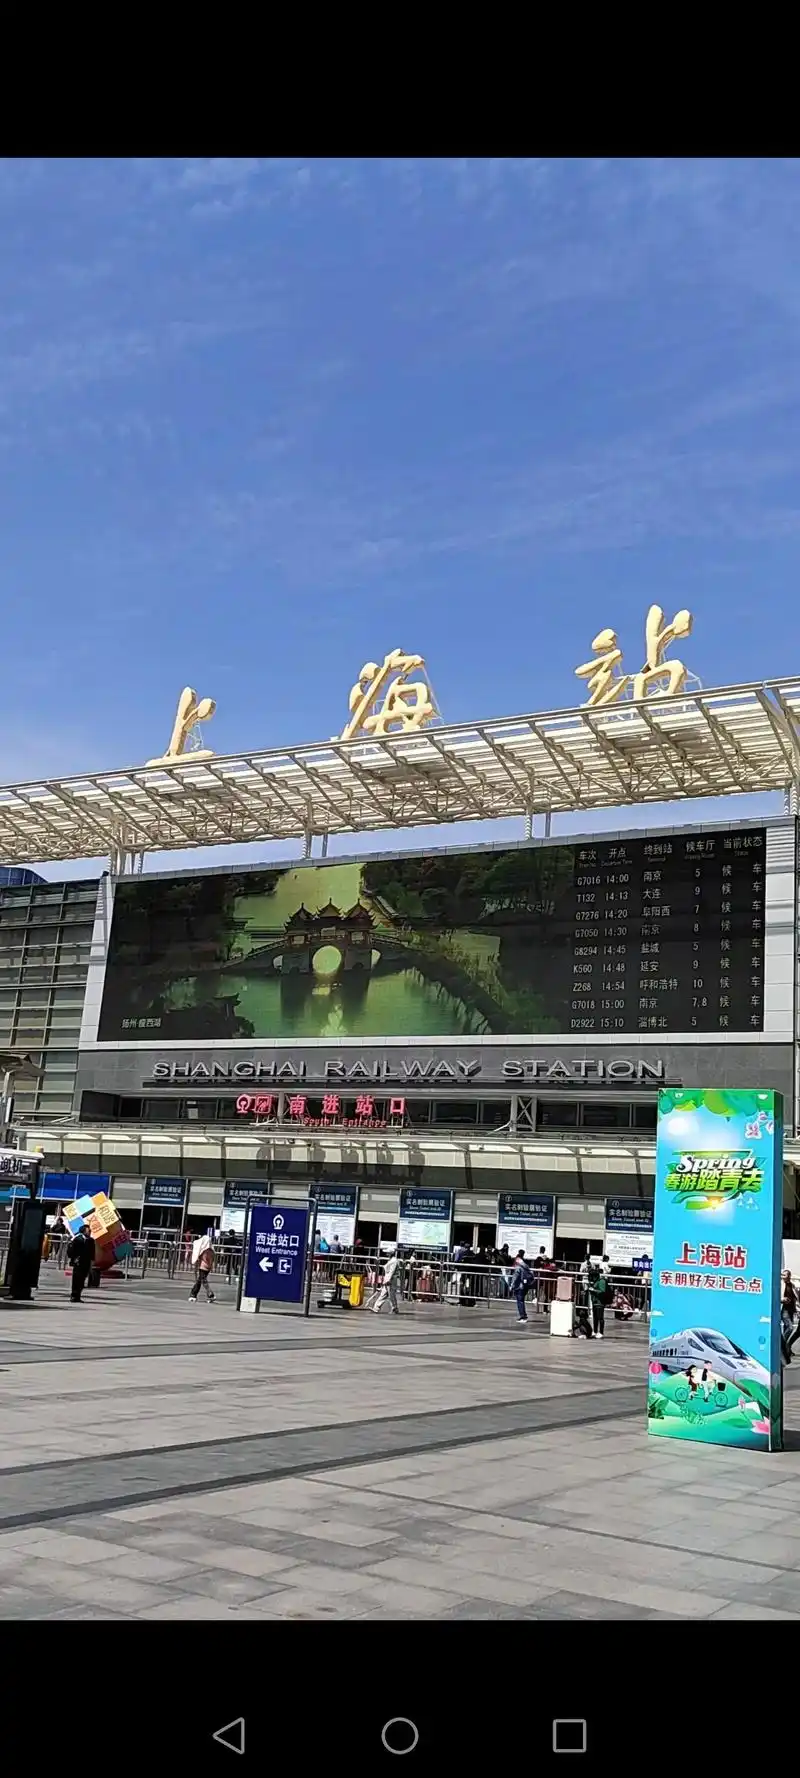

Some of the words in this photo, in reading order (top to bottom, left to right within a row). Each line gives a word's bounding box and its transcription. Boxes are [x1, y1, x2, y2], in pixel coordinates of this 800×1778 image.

[579, 849, 597, 860] 车次
[608, 847, 627, 859] 开点
[643, 843, 672, 855] 终到站
[685, 840, 715, 852] 候车厅
[723, 836, 763, 849] 当前状态
[578, 876, 600, 886] G7016
[606, 874, 629, 884] 14:00
[644, 871, 661, 882] 南京
[695, 869, 701, 877] 5
[577, 894, 595, 902] T132
[605, 892, 628, 901] 14:13
[643, 889, 661, 900] 大连
[695, 887, 700, 896] 9
[576, 911, 599, 921] G7276
[604, 910, 628, 919] 14:20
[642, 906, 671, 917] 阜阳西
[695, 905, 700, 914] 7
[575, 929, 598, 938] G7050
[604, 927, 627, 937] 14:30
[694, 924, 699, 932] 8
[603, 945, 626, 954] 14:45
[693, 942, 698, 951] 5
[573, 964, 592, 973] K560
[602, 963, 625, 973] 14:48
[640, 961, 659, 972] 延安
[693, 960, 698, 968] 9
[573, 982, 592, 992] Z268
[602, 981, 625, 990] 14:54
[640, 979, 678, 990] 呼和浩特
[693, 979, 703, 988] 10
[572, 1000, 595, 1009] G7018
[601, 999, 625, 1009] 15:00
[639, 998, 658, 1009] 南京
[571, 1019, 595, 1028] D2922
[600, 1018, 624, 1028] 15:10
[638, 1016, 668, 1028] 淄博北
[692, 1016, 697, 1026] 5
[153, 1060, 305, 1077] SHANGHAI
[324, 1060, 478, 1077] RAILWAY
[501, 1060, 663, 1077] STATION
[289, 1095, 405, 1115] 南进站口
[303, 1117, 330, 1126] South
[342, 1117, 387, 1128] Entrance
[676, 1153, 755, 1173] Spring
[665, 1169, 764, 1192] 春游踏青去
[255, 1232, 299, 1247] 西进站口
[255, 1246, 270, 1254] West
[271, 1247, 298, 1256] Entrance
[676, 1242, 746, 1268] 上海站
[661, 1271, 762, 1293] 亲朋好友汇合点
